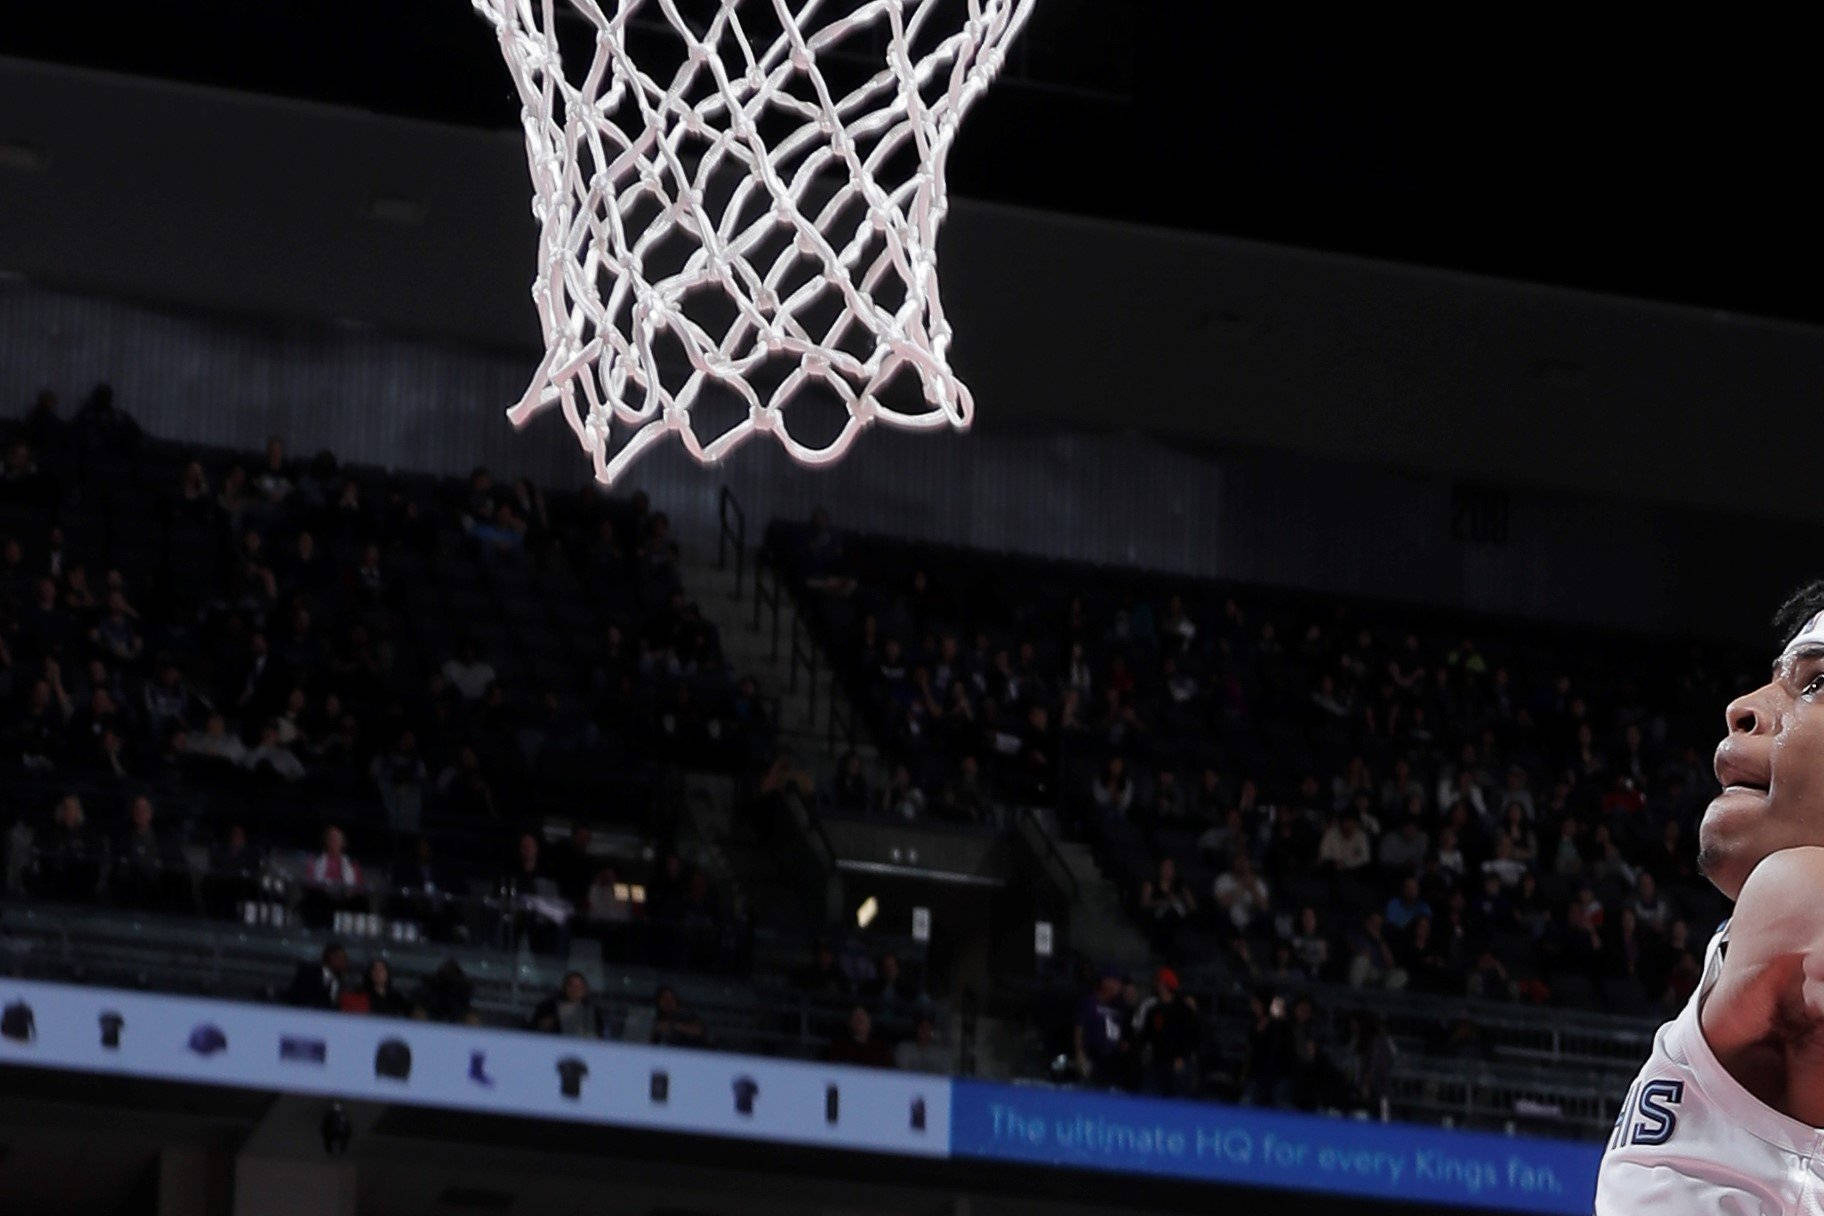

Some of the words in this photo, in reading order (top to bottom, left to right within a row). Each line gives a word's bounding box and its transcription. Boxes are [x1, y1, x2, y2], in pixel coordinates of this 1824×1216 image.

[988, 1102, 1046, 1144] The
[1055, 1113, 1187, 1157] ultimate
[1196, 1127, 1252, 1164] HQ
[1264, 1131, 1306, 1168] for
[1318, 1145, 1402, 1186] every
[1416, 1149, 1497, 1194] Kings
